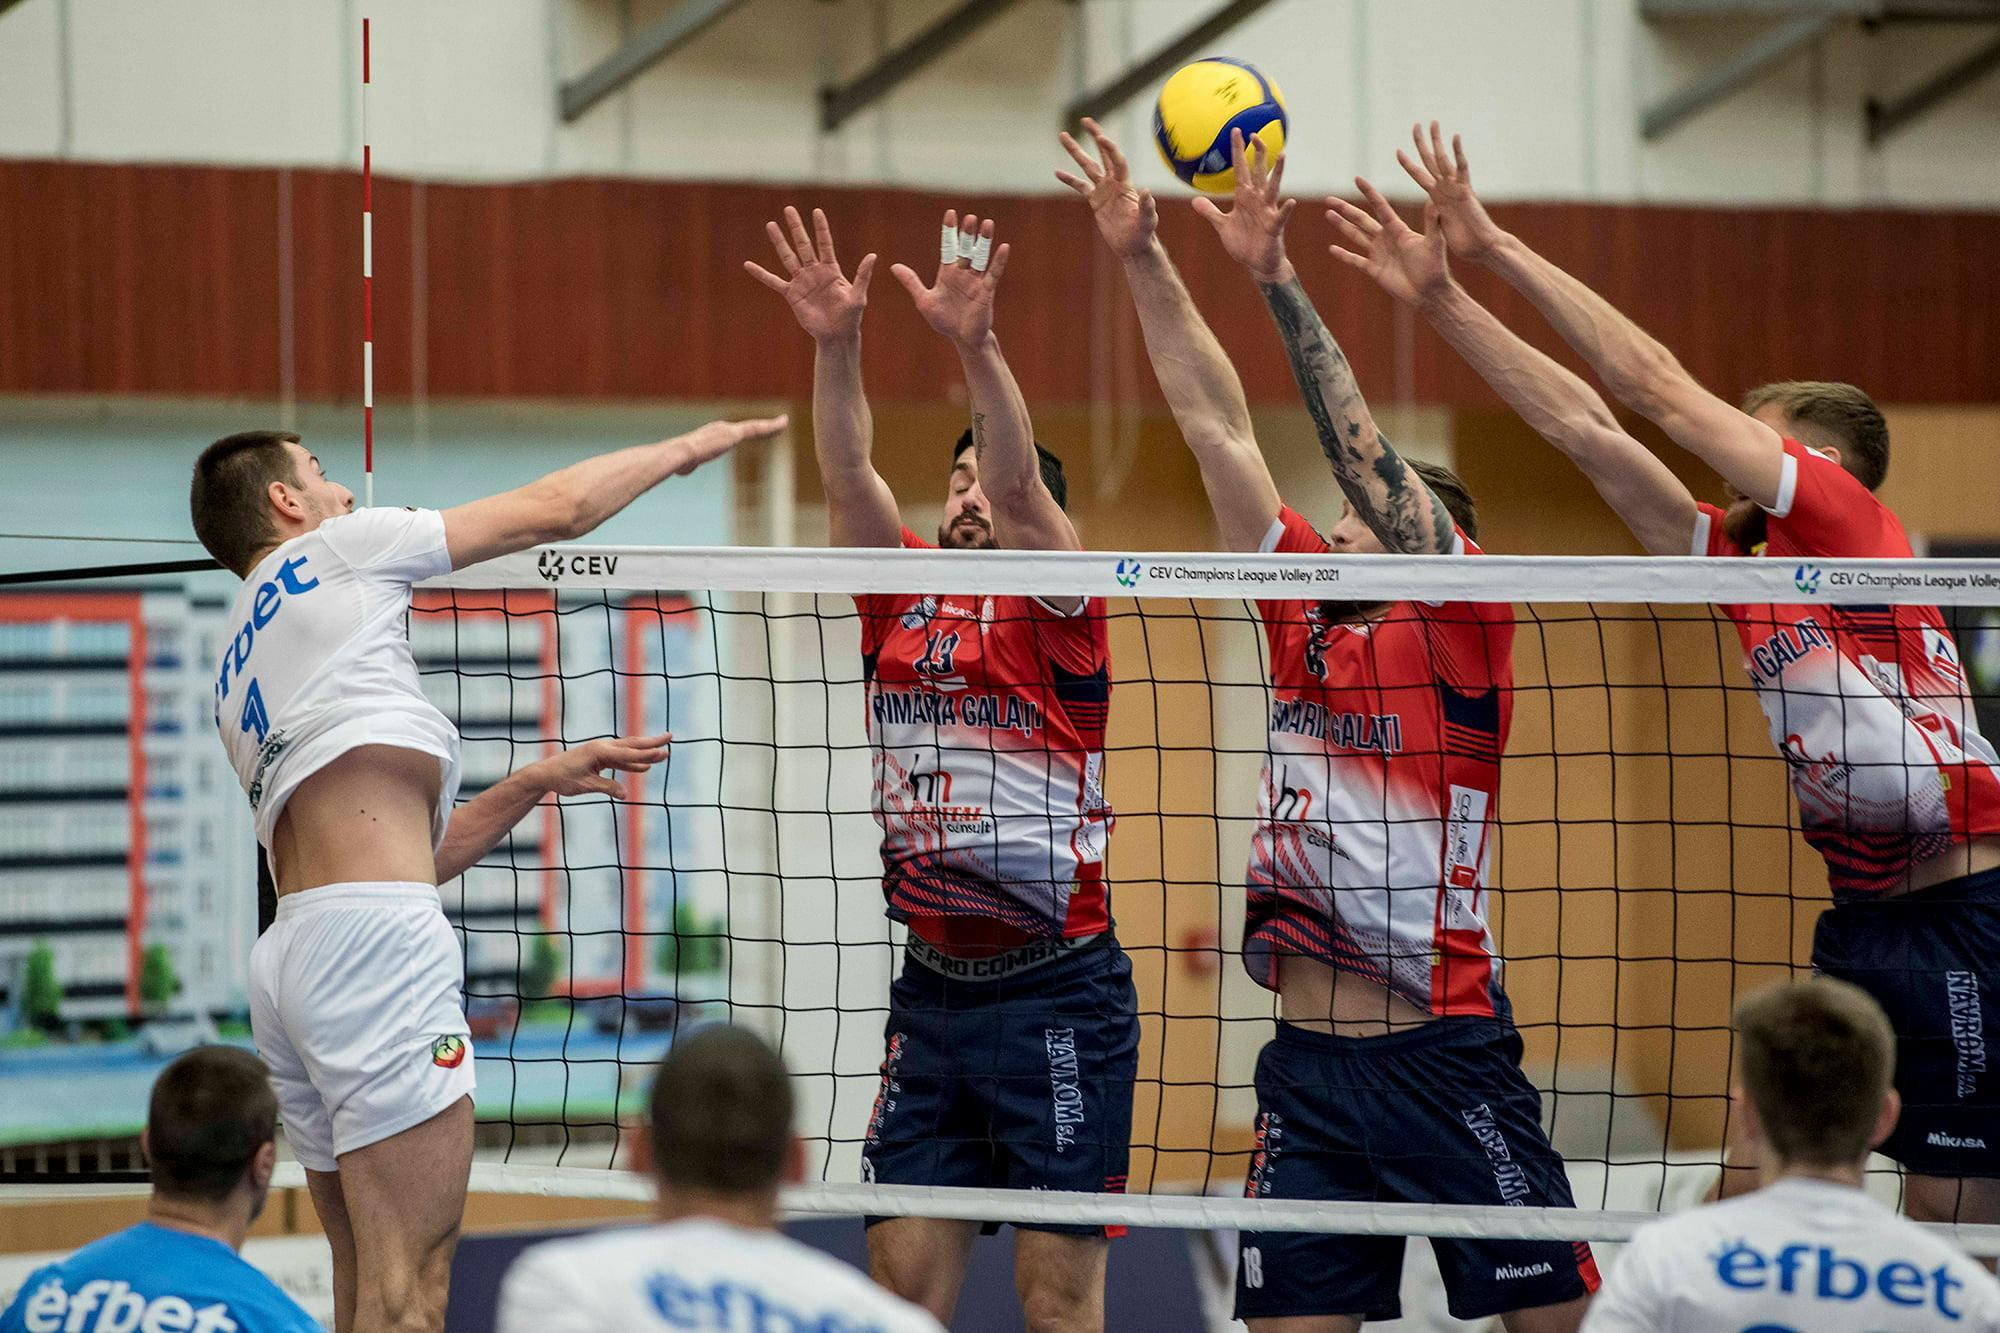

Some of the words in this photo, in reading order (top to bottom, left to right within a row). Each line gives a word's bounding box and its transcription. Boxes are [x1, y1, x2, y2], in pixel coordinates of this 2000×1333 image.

[571, 556, 618, 575] CEV
[1149, 567, 1173, 579] CEV
[1175, 567, 1235, 583] Champions
[1237, 568, 1278, 584] League
[1280, 568, 1313, 584] Volley
[1315, 569, 1339, 581] 2021
[1830, 572, 1855, 585] CEV
[1857, 572, 1921, 588] Champions
[1924, 574, 1967, 589] League
[214, 556, 320, 728] fbet
[1243, 1247, 1264, 1289] 18
[1717, 1244, 1964, 1320] efbet
[24, 1279, 238, 1333] efbet
